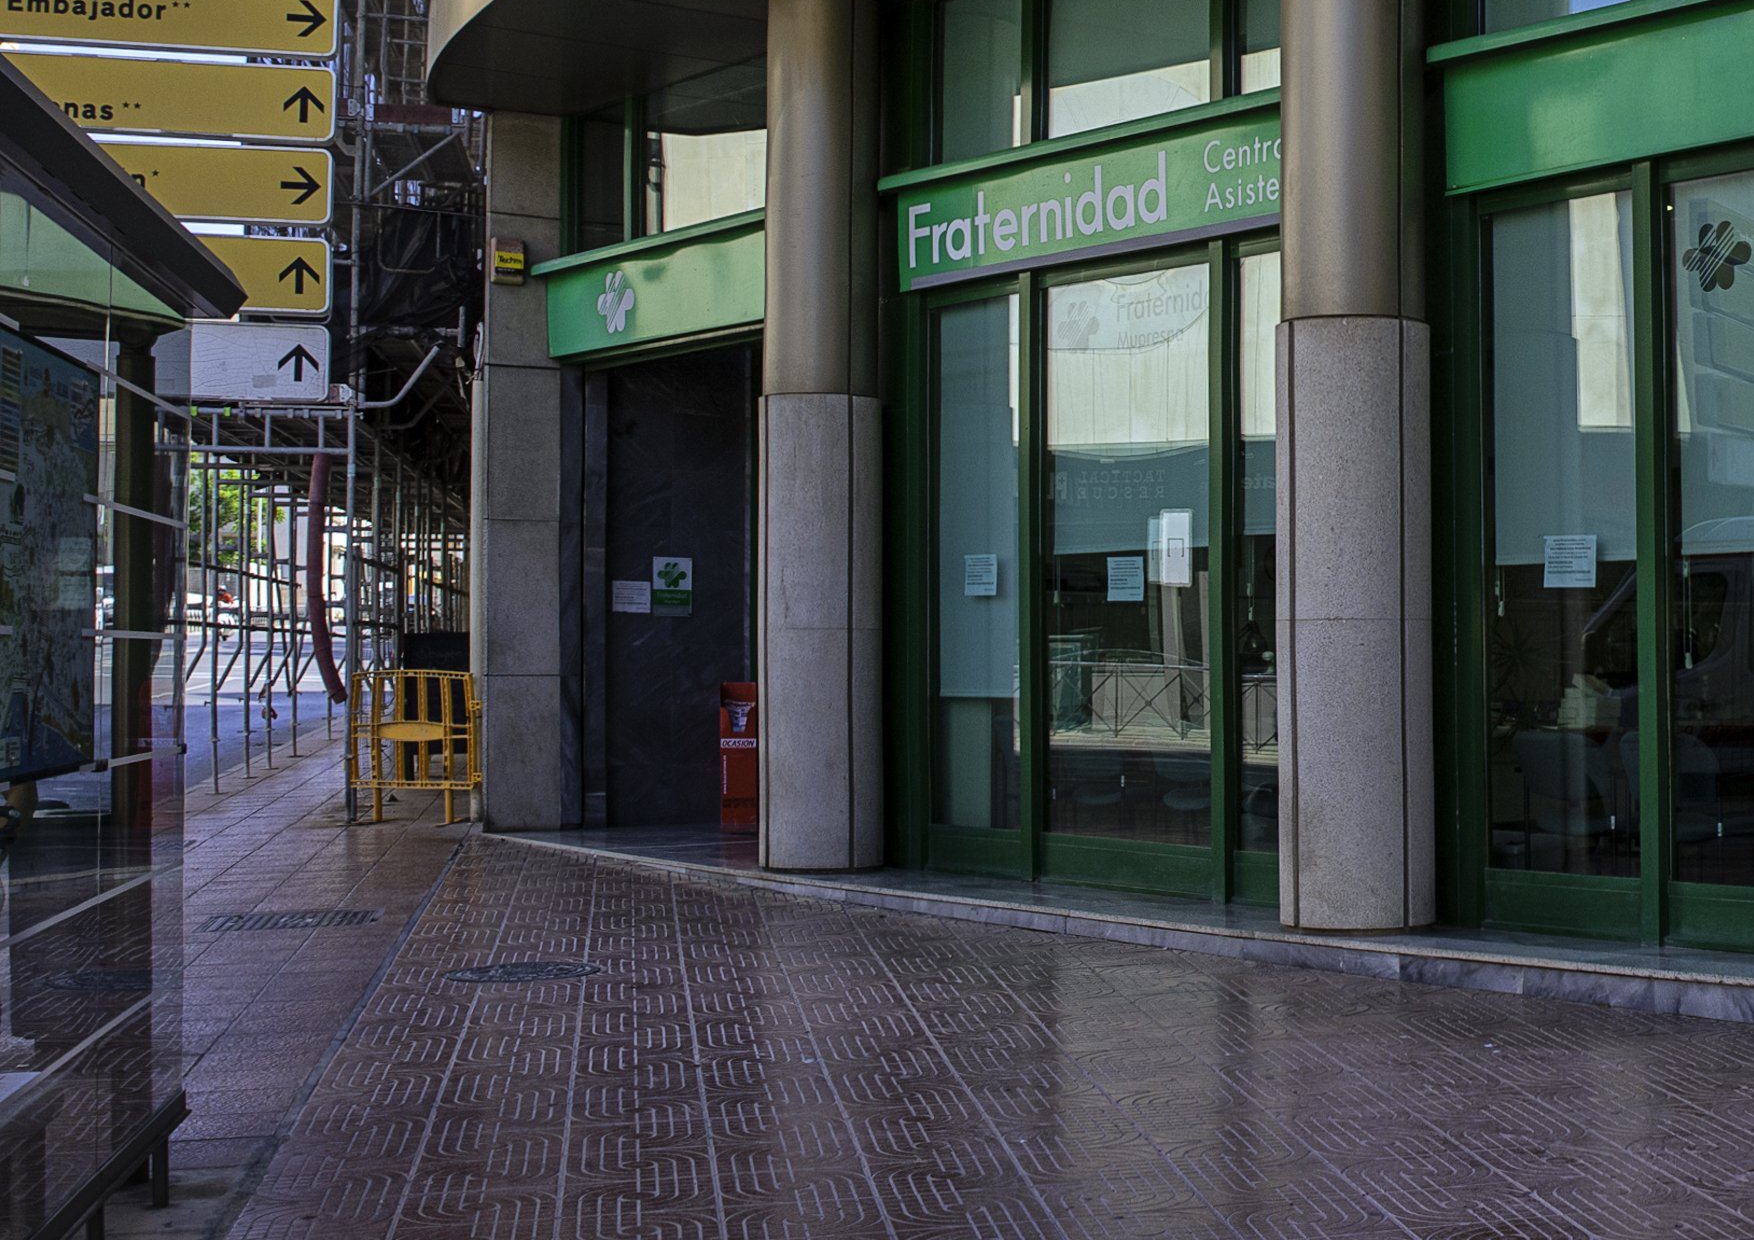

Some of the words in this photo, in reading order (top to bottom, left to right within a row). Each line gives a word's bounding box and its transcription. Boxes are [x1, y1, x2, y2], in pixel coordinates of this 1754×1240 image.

[54, 101, 114, 121] nas
[908, 150, 1168, 269] Fraternidad
[1116, 280, 1208, 322] Fraternid
